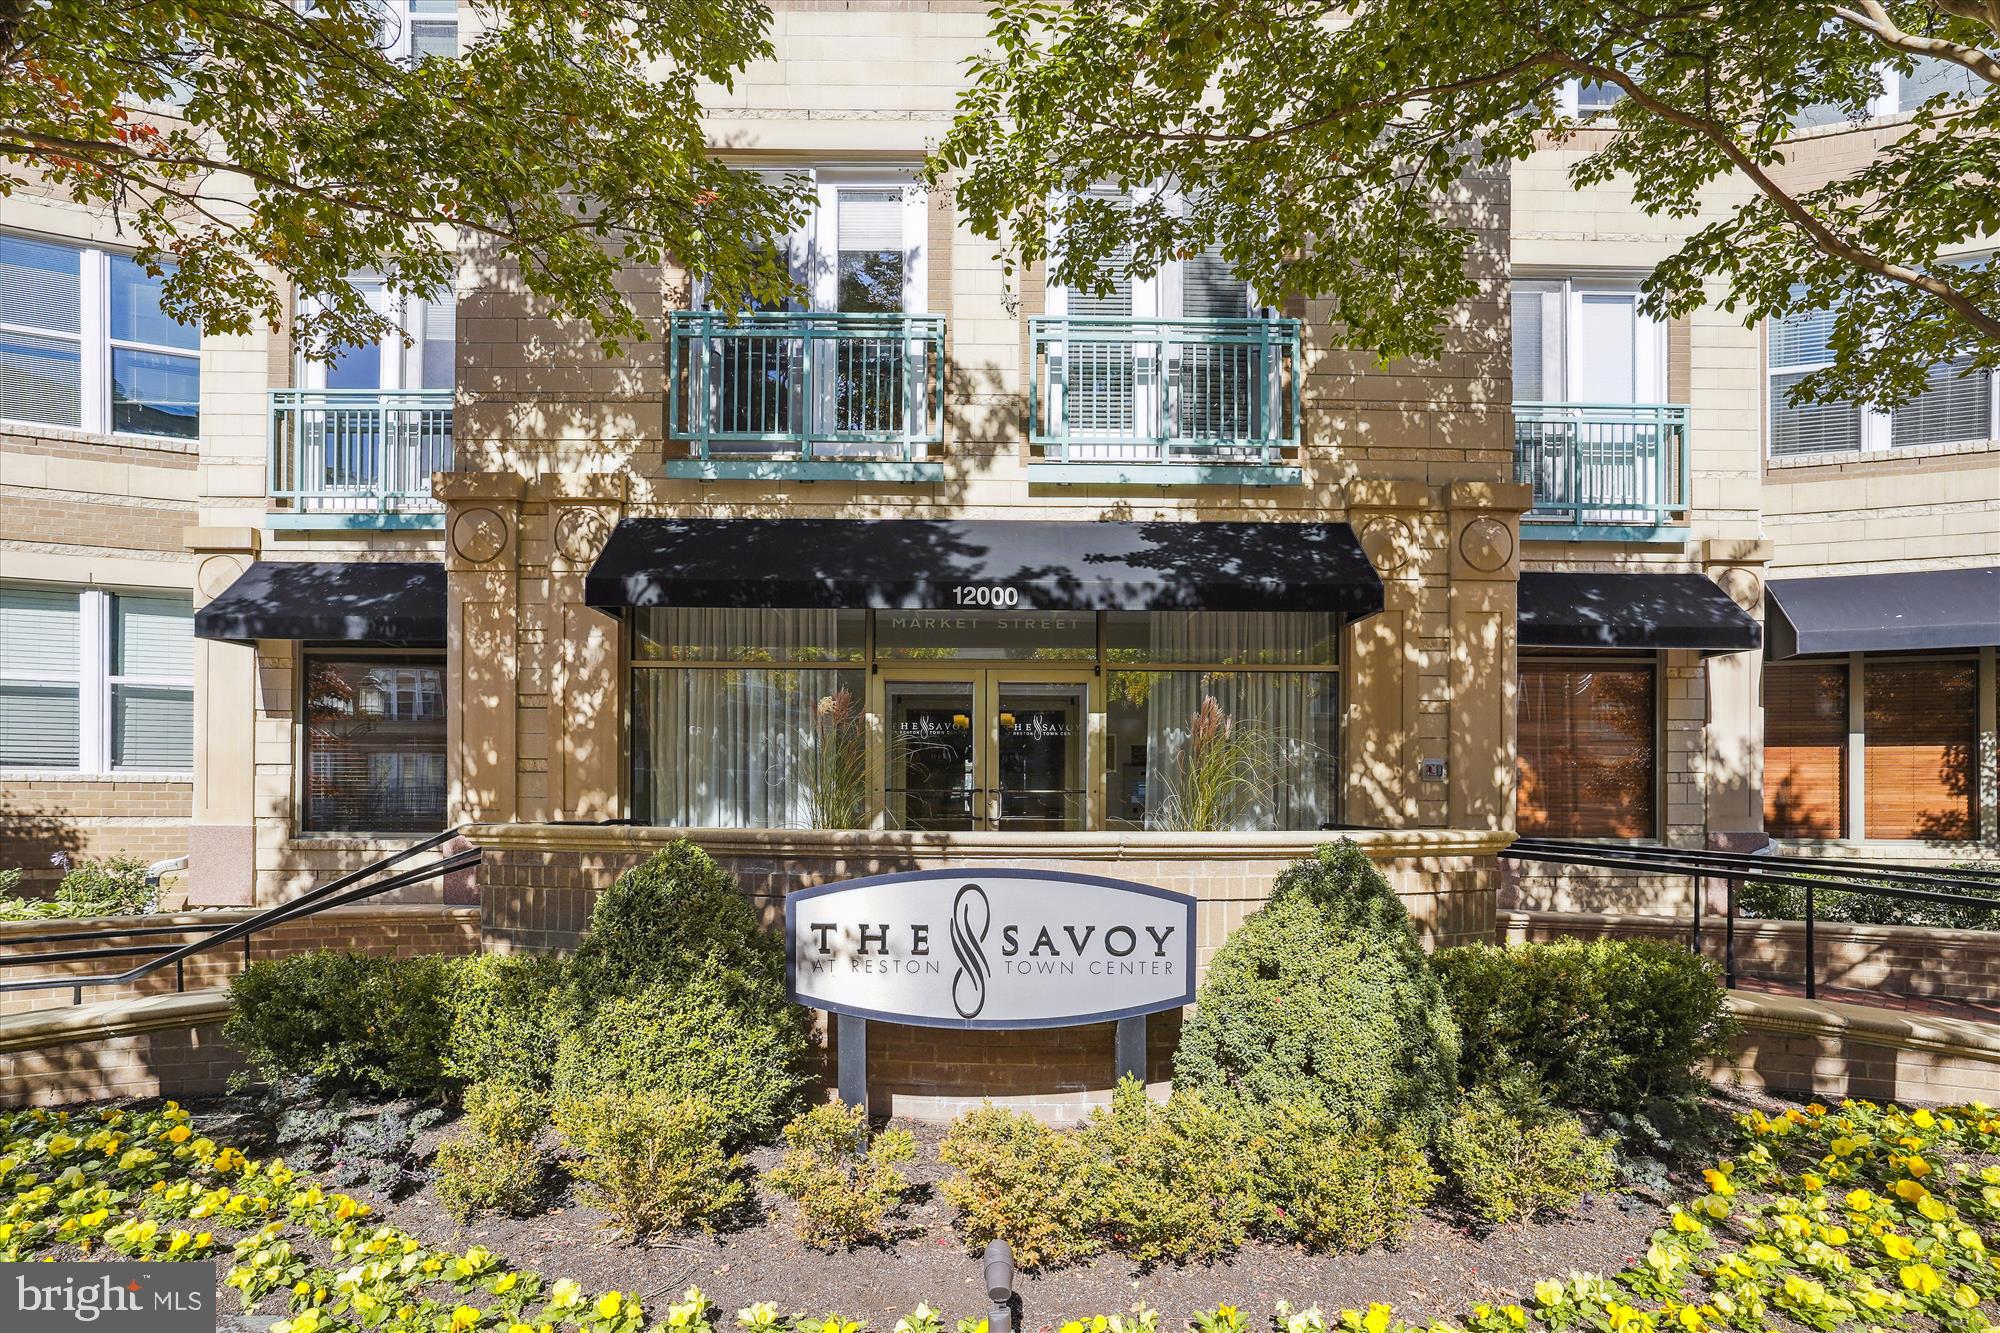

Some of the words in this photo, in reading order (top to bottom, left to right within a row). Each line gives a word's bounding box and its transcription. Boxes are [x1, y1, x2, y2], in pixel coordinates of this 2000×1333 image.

[952, 586, 1019, 606] 12000
[892, 617, 980, 629] MARKET
[997, 618, 1079, 630] STREET
[810, 922, 930, 956] THE
[1002, 924, 1175, 958] SAVOY
[812, 959, 836, 974] AT
[851, 959, 940, 975] RESTON
[1004, 960, 1074, 975] TOWN
[1089, 960, 1174, 976] CENTER
